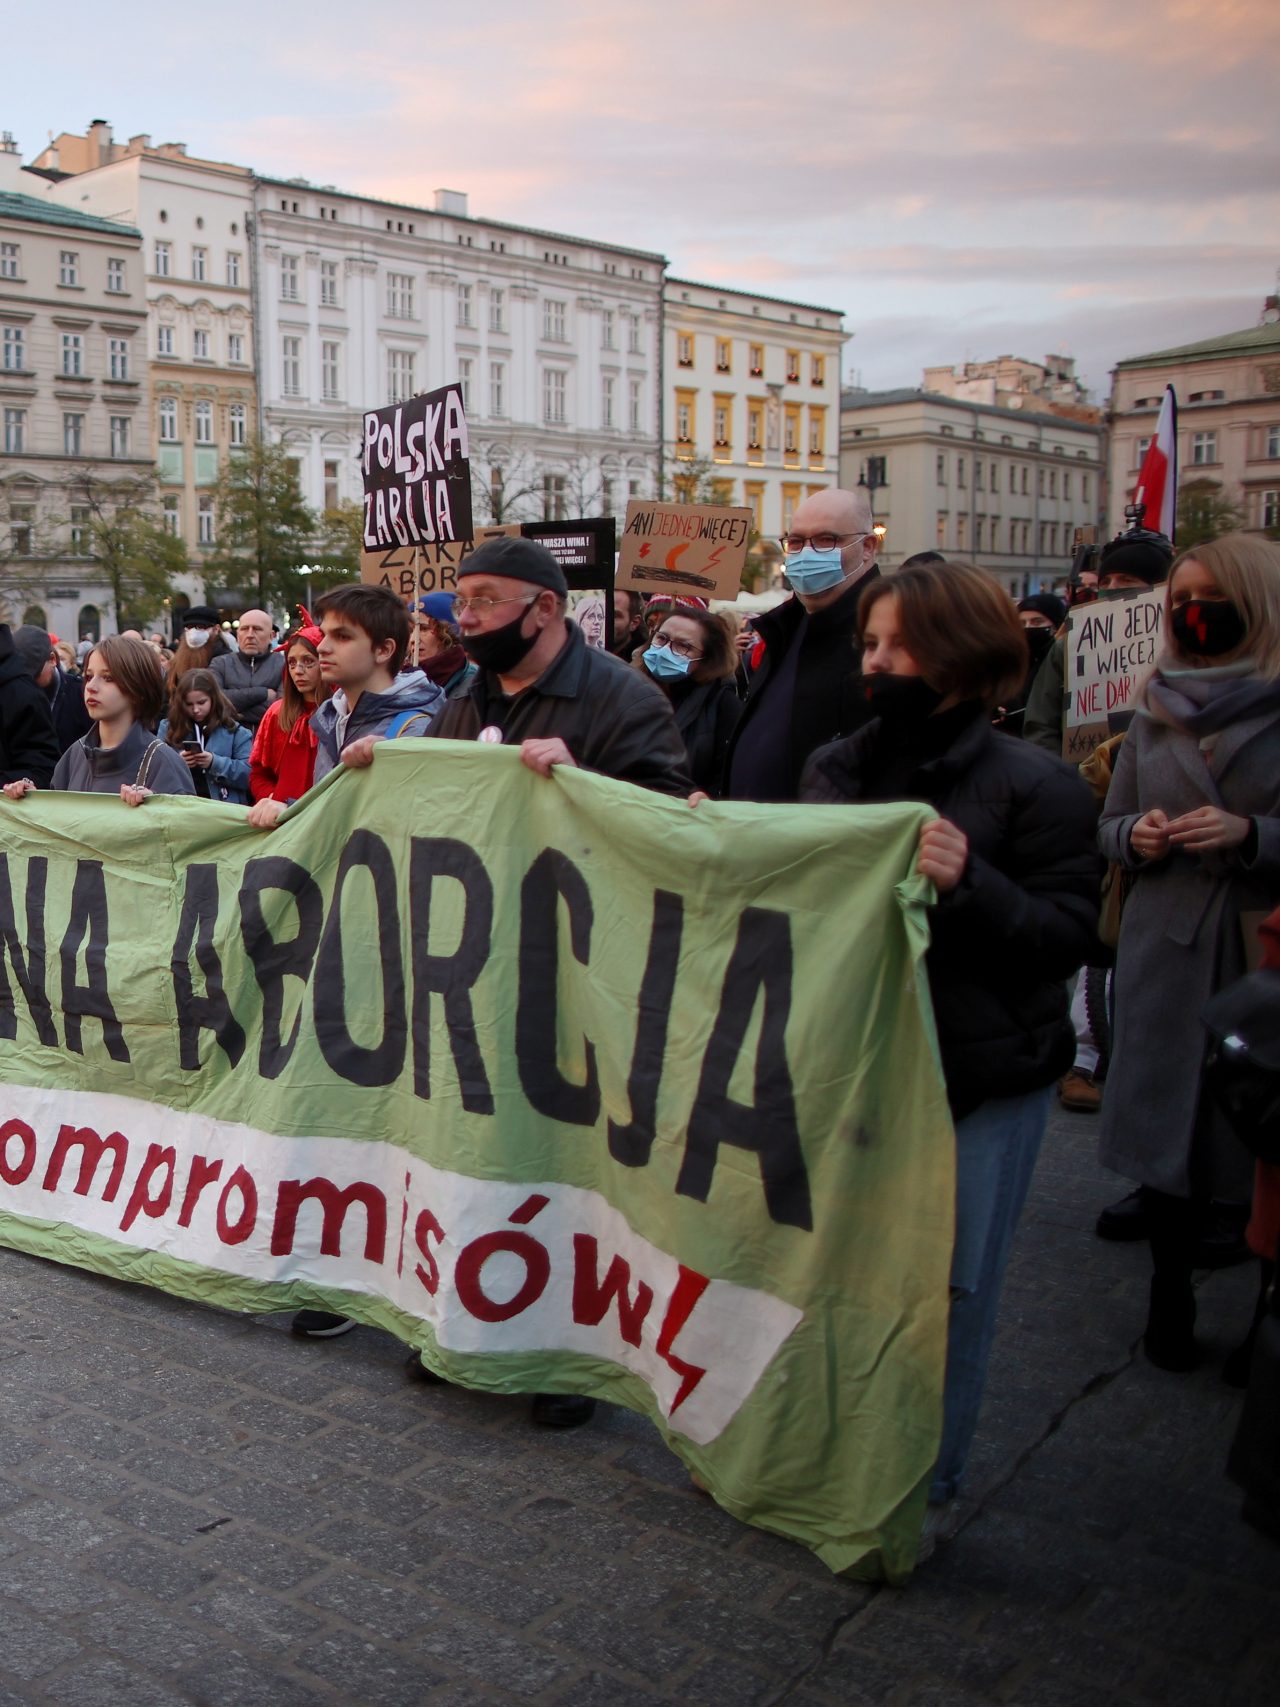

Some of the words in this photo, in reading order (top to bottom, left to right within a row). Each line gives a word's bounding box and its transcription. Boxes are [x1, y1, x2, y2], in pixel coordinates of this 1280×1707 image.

[363, 389, 470, 484] POLSKA
[363, 479, 455, 547] ZABIJA
[653, 512, 701, 540] JEDNEJ
[543, 537, 565, 548] WASZA
[1076, 613, 1114, 653] ANI
[1097, 637, 1156, 675] WIĘCEJ
[1077, 683, 1103, 717] NIE
[170, 827, 813, 1232] ABORCJA
